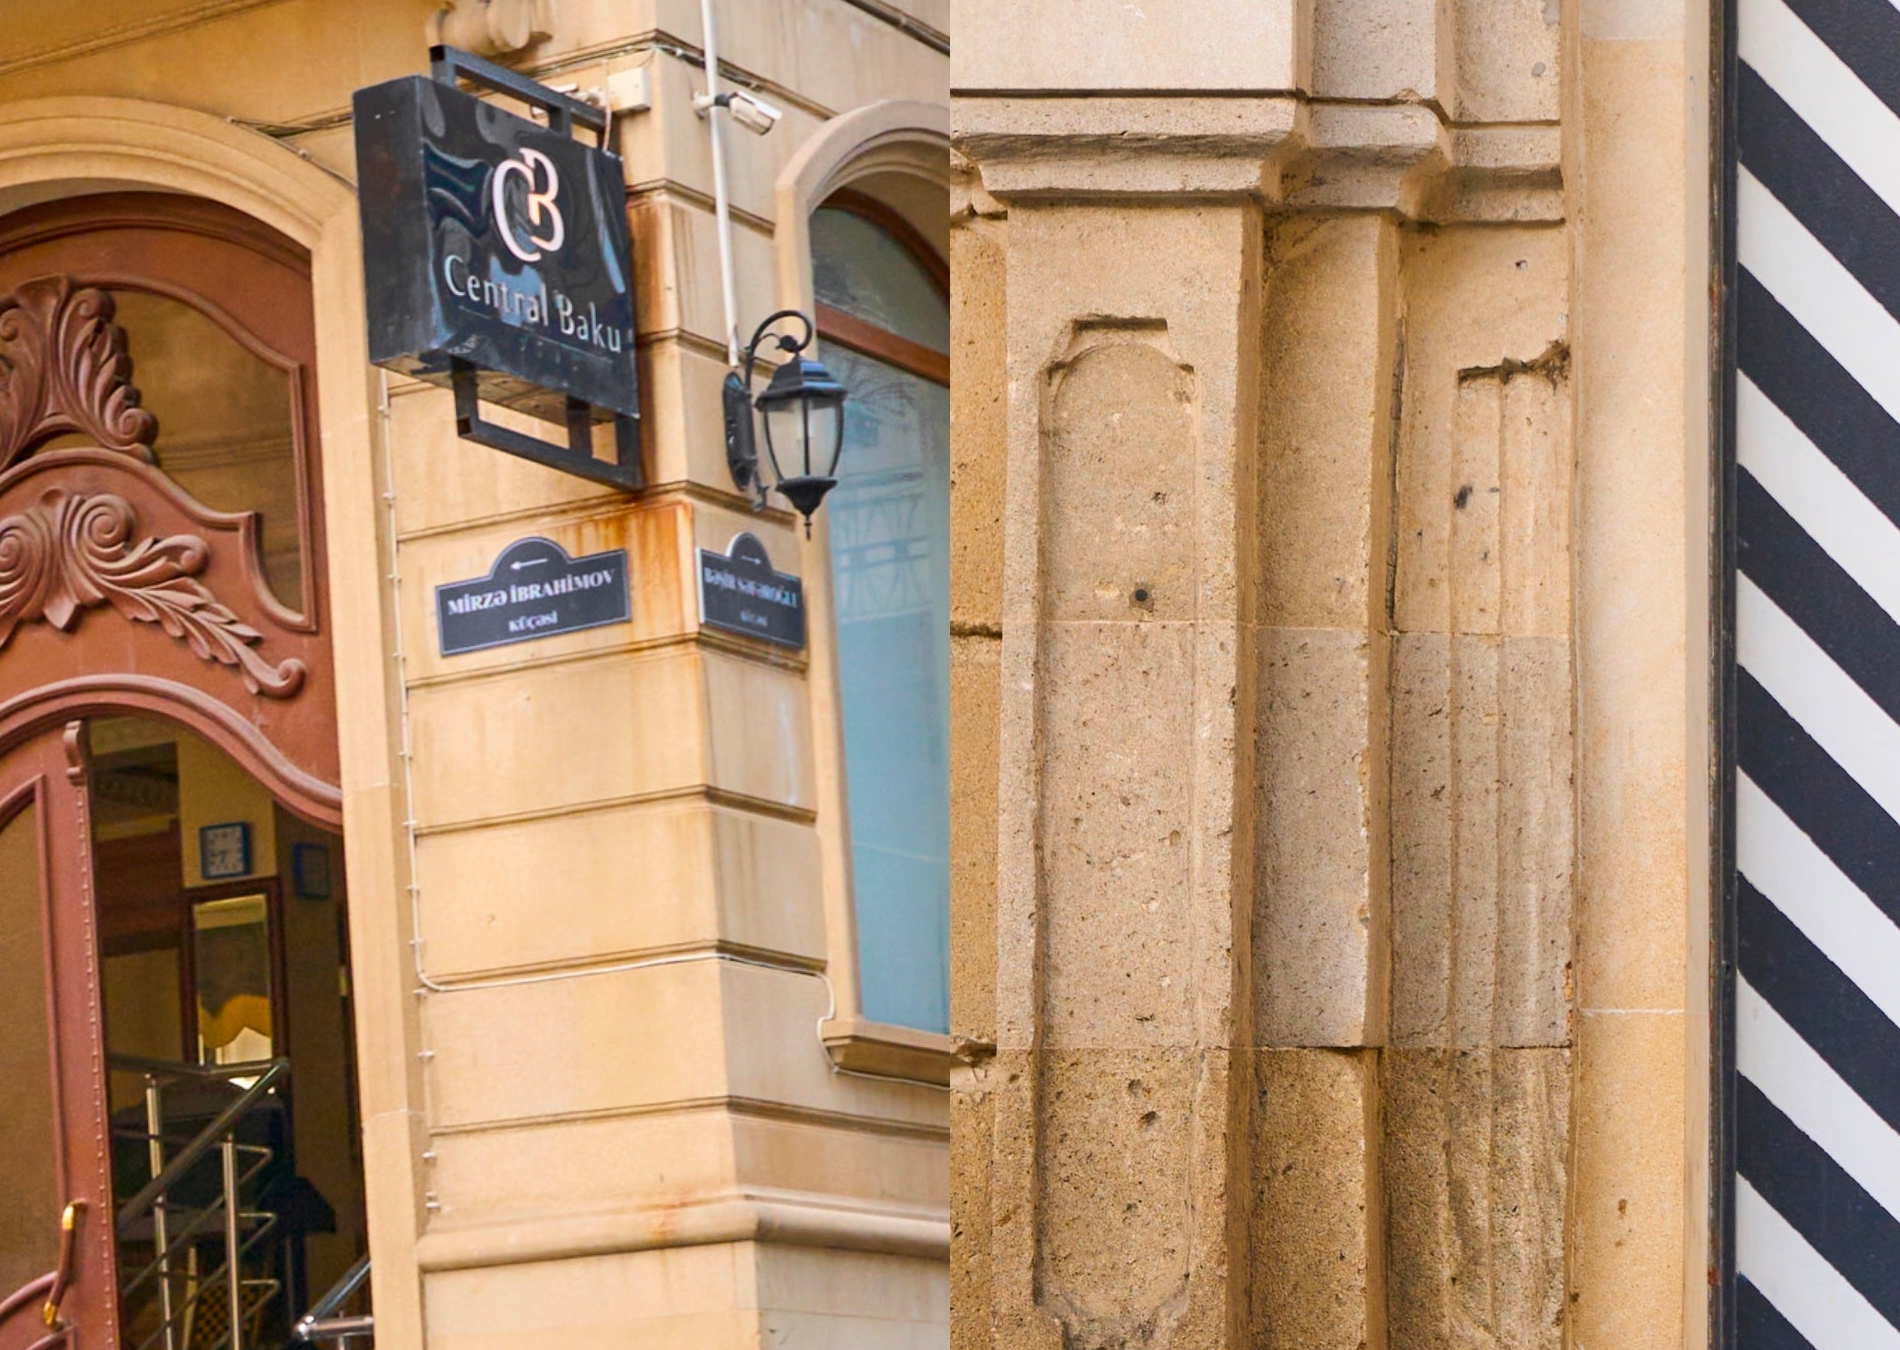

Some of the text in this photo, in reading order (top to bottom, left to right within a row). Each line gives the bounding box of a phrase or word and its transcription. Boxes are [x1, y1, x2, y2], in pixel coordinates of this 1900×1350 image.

[444, 254, 621, 353] Central Baku
[447, 568, 616, 615] MİRZƏ İBRAHİMOV
